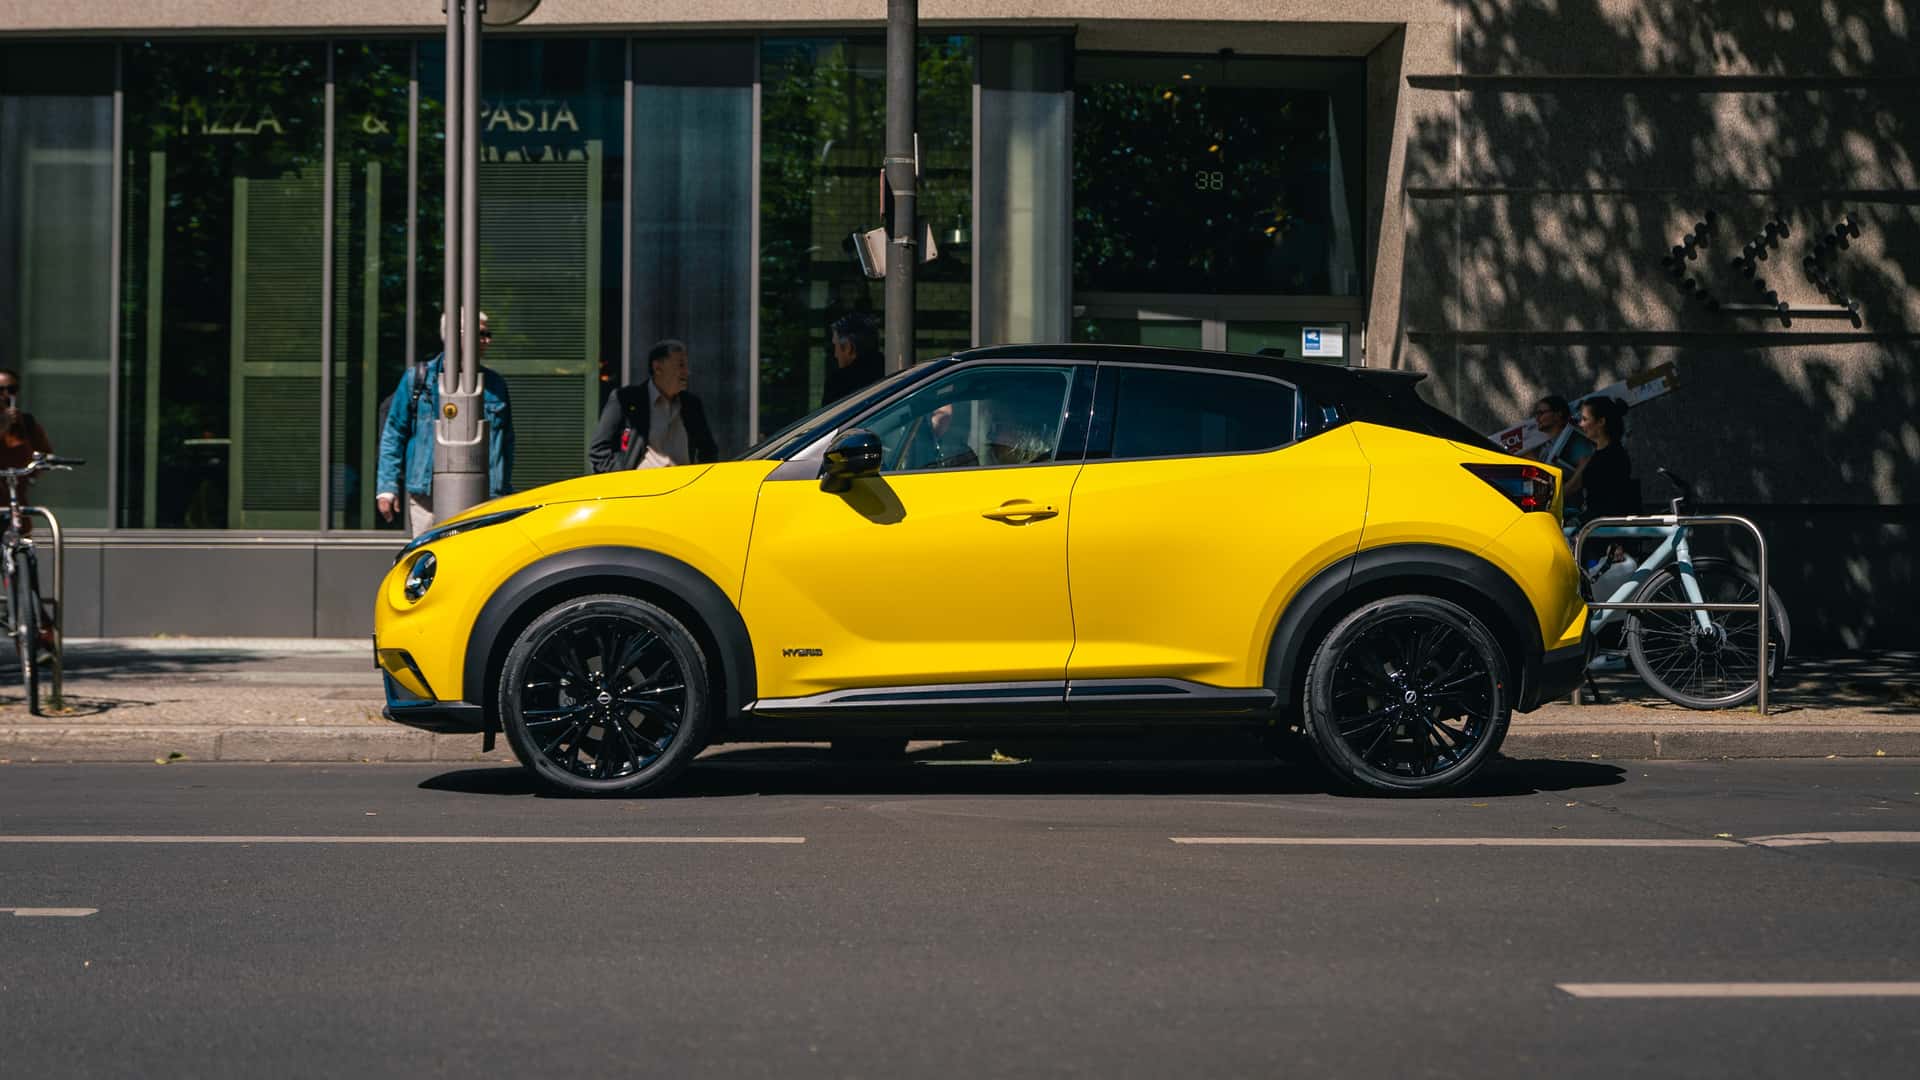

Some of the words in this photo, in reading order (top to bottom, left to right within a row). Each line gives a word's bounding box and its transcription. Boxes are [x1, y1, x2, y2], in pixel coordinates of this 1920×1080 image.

[362, 103, 390, 134] &
[1195, 170, 1224, 190] 38
[782, 648, 823, 657] HYBRID
